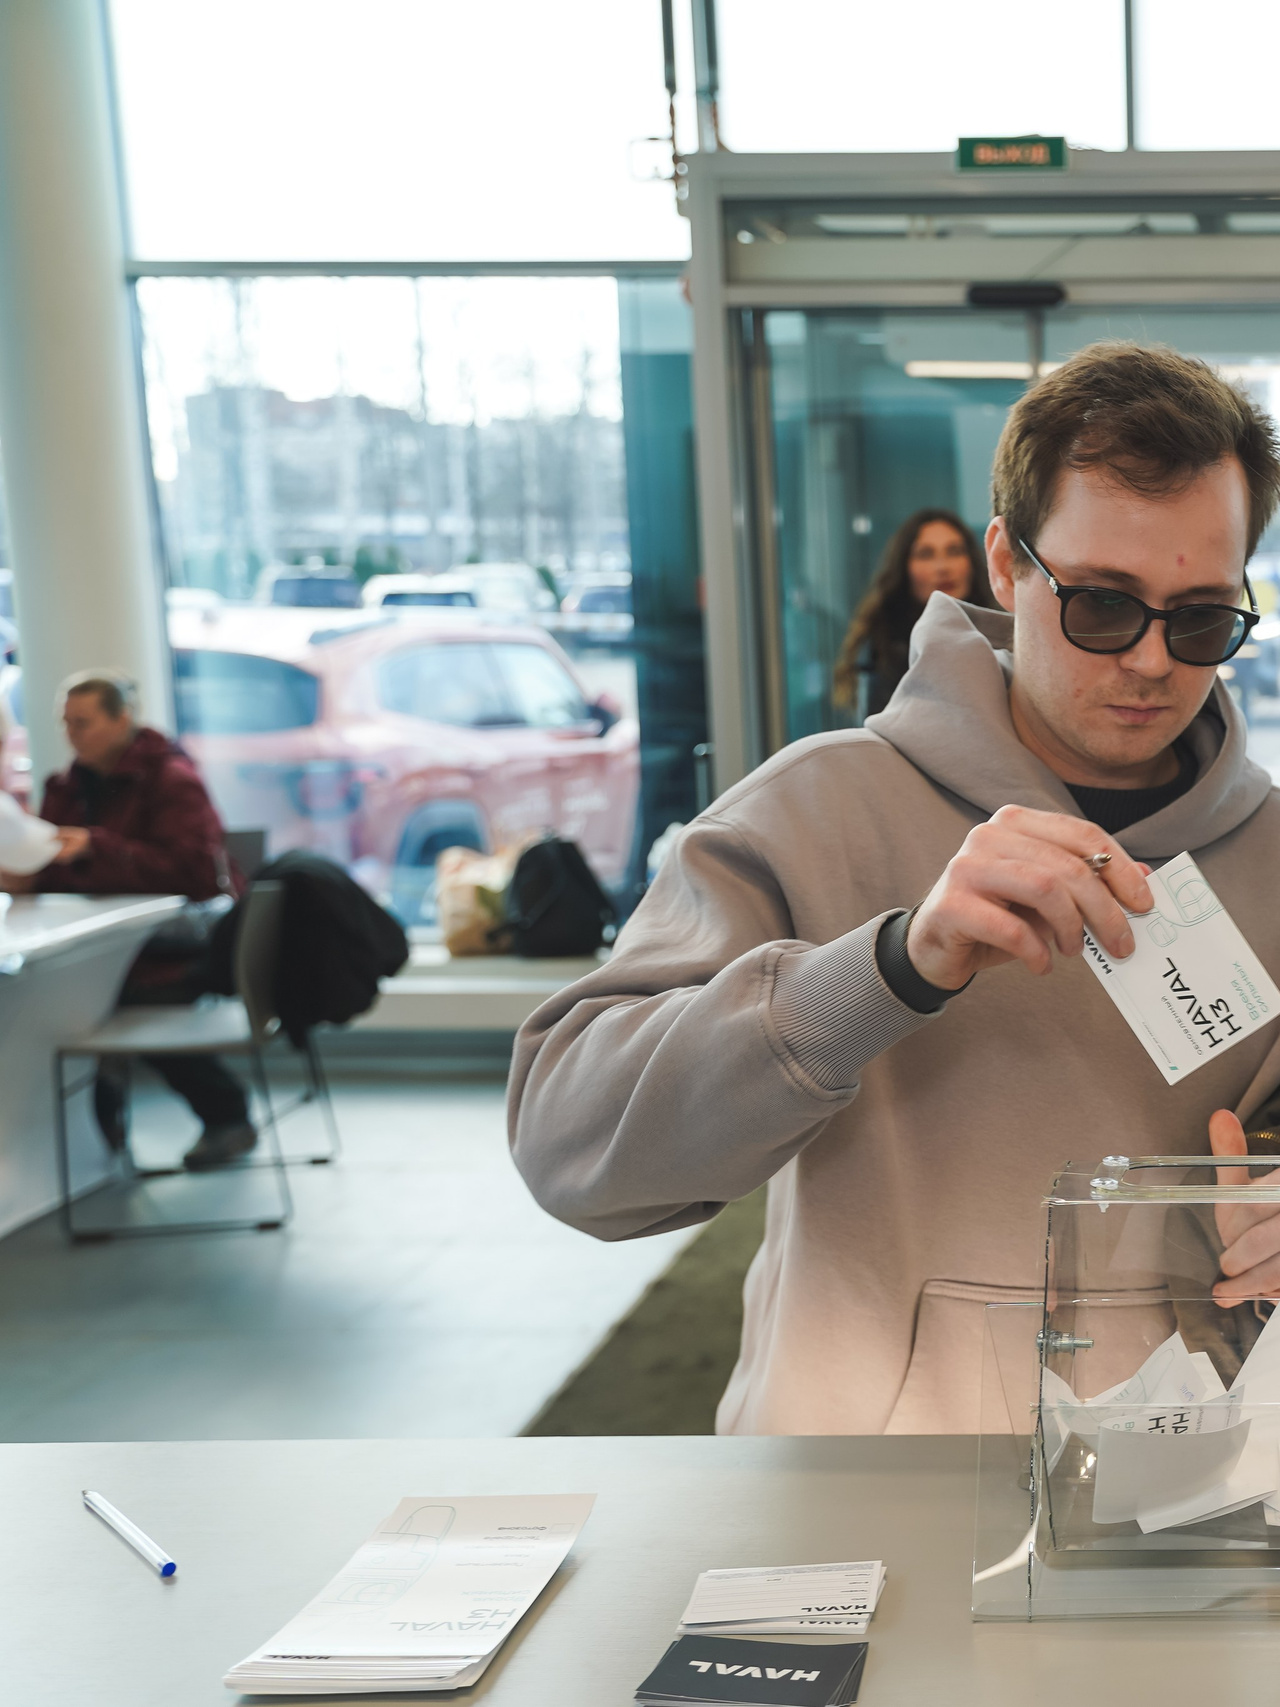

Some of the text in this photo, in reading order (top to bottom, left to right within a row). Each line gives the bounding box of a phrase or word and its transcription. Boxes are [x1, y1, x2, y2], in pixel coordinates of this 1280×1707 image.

[1162, 957, 1223, 1048] HAVAL
[1231, 979, 1259, 1021] Время
[1232, 961, 1268, 1014] сильных
[1209, 997, 1243, 1036] H3
[465, 1607, 517, 1618] H3
[800, 1604, 867, 1612] HAVAL
[389, 1620, 507, 1631] HAVAL
[689, 1660, 820, 1681] HAVAL
